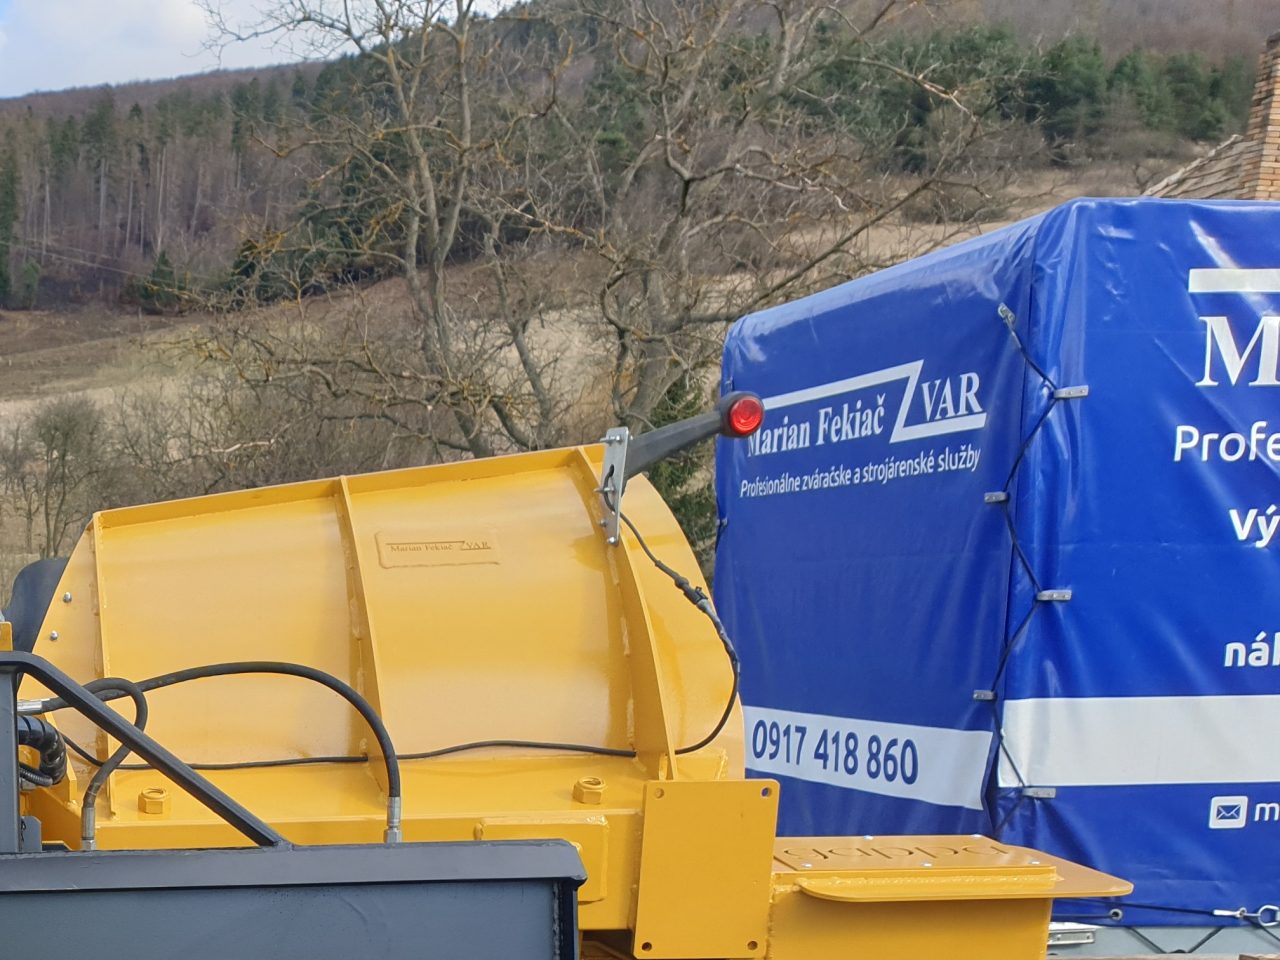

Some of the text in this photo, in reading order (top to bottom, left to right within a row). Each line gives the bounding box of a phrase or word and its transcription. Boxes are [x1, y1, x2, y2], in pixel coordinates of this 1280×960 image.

[816, 392, 886, 446] Fekiač
[739, 472, 801, 498] Profesionálne
[853, 467, 861, 484] a
[863, 449, 934, 485] strojárenské
[937, 443, 981, 472] služby
[1229, 504, 1280, 548] Vý
[752, 719, 919, 785] 0917 418 860
